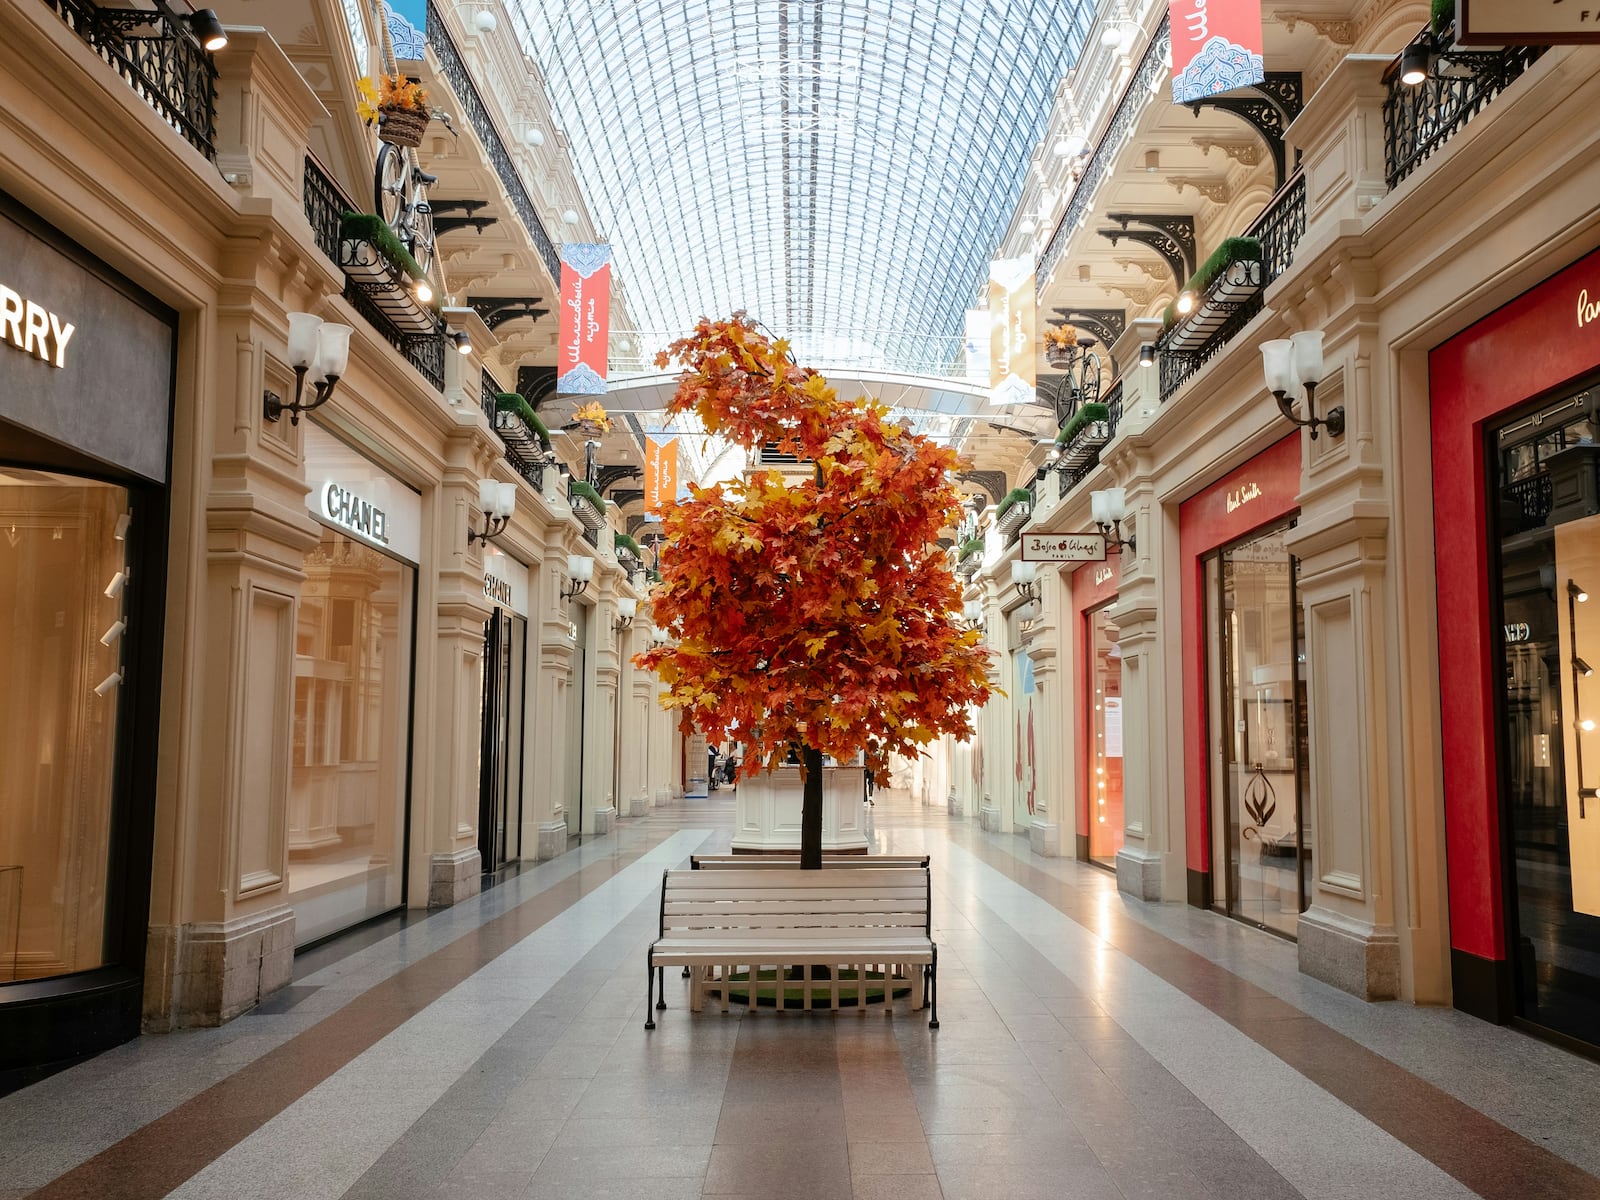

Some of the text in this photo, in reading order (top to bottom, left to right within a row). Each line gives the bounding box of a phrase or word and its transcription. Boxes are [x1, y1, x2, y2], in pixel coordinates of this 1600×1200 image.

[567, 278, 582, 362] Шелковый
[586, 298, 600, 343] путь
[325, 483, 389, 545] CHANEL
[1226, 482, 1262, 513] Paul Smith
